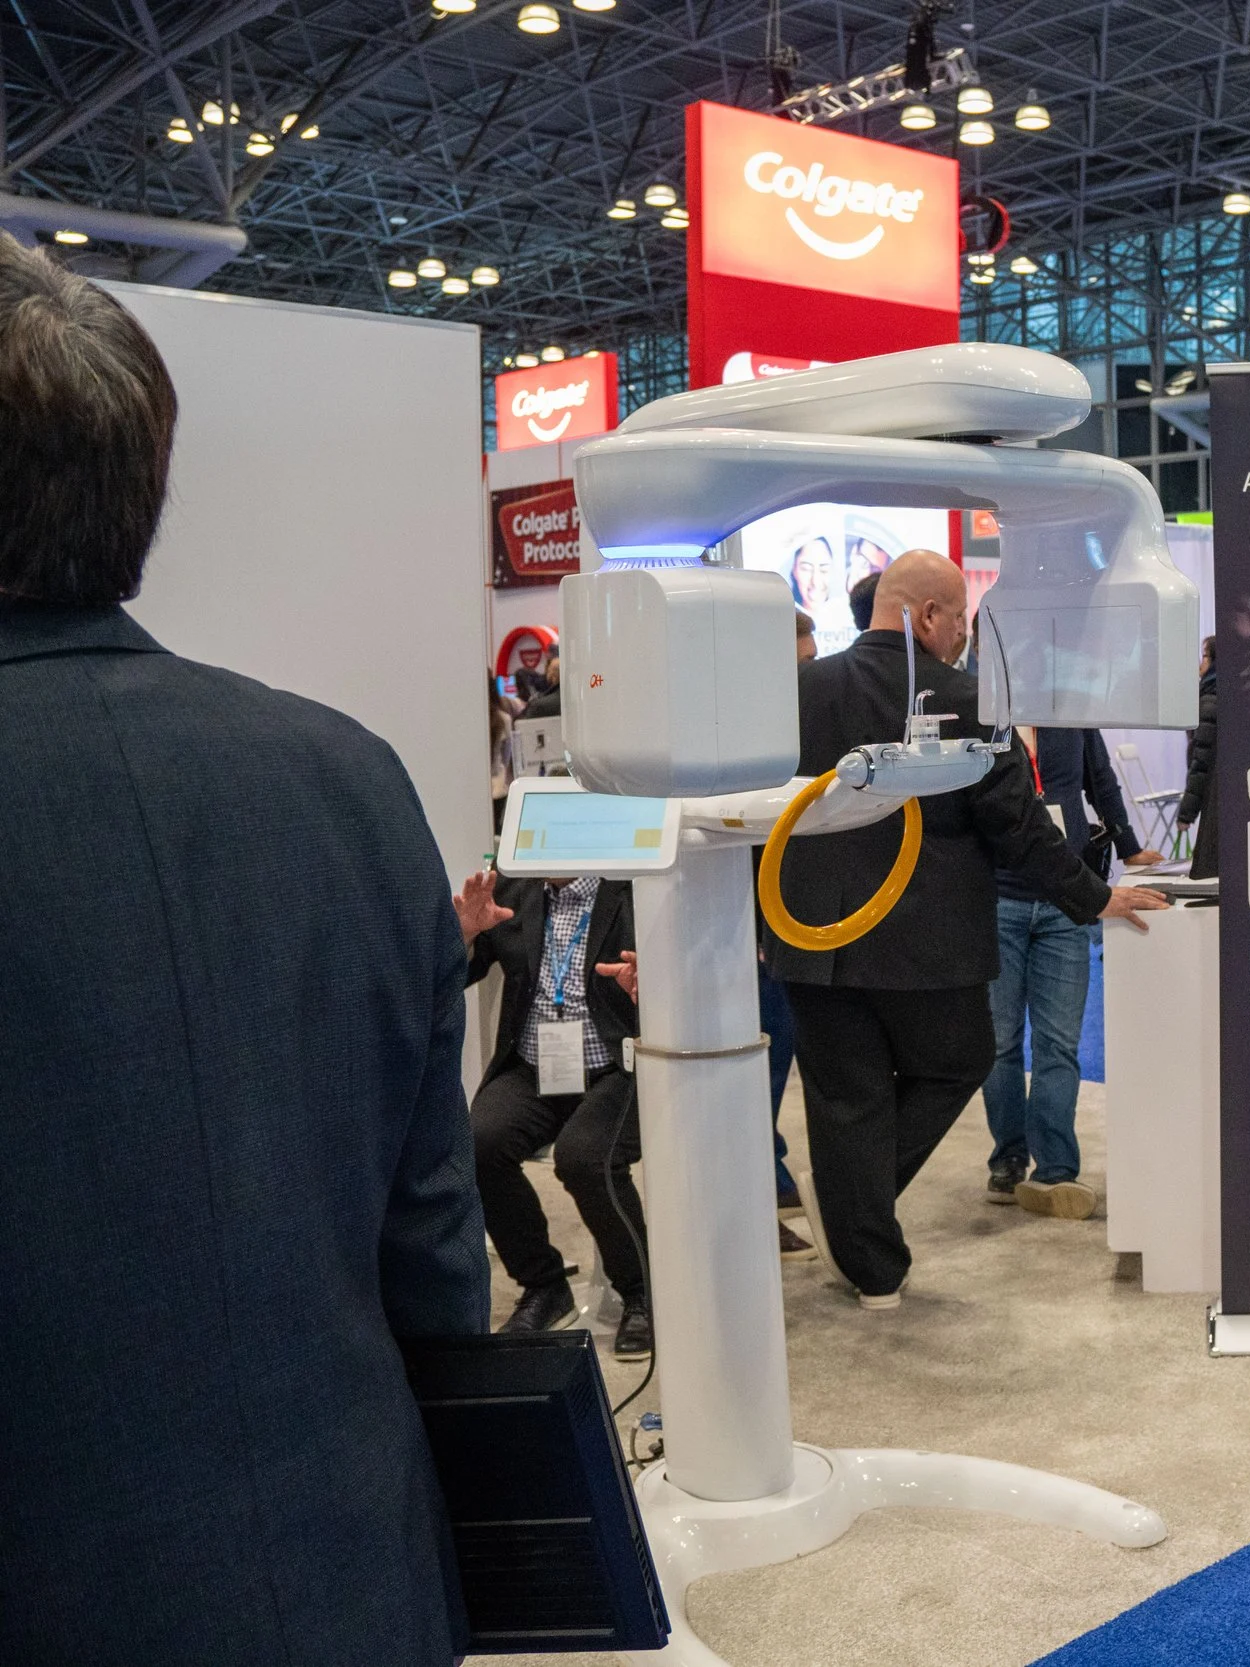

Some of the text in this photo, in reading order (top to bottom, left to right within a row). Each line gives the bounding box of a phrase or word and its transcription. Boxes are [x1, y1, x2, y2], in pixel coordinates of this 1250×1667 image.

[744, 151, 923, 223] Colgate
[512, 380, 589, 419] Colgate
[512, 510, 569, 540] Colgate
